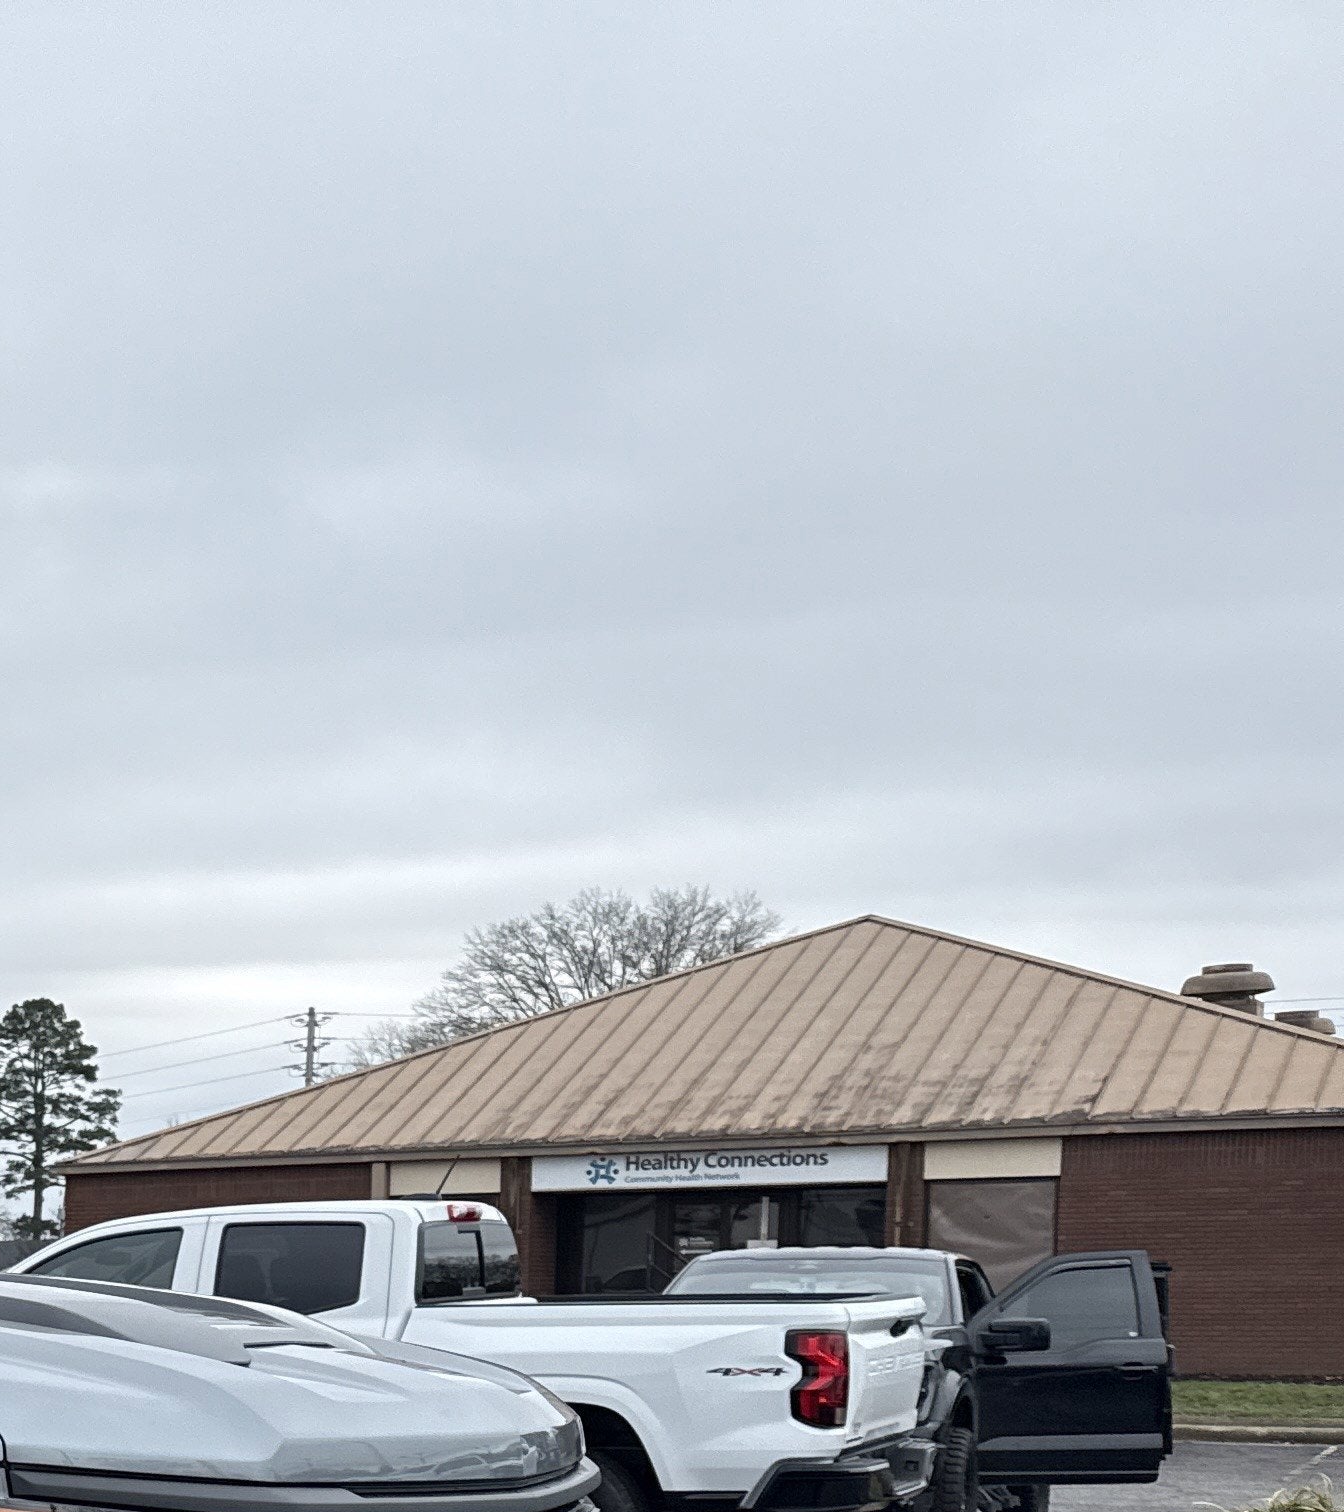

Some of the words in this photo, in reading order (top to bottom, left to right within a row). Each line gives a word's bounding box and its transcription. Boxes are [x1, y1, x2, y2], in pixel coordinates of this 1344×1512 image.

[625, 1152, 700, 1174] Healthy
[704, 1150, 829, 1168] Connections
[625, 1175, 673, 1184] Community
[675, 1174, 702, 1183] Health
[704, 1172, 741, 1181] Network
